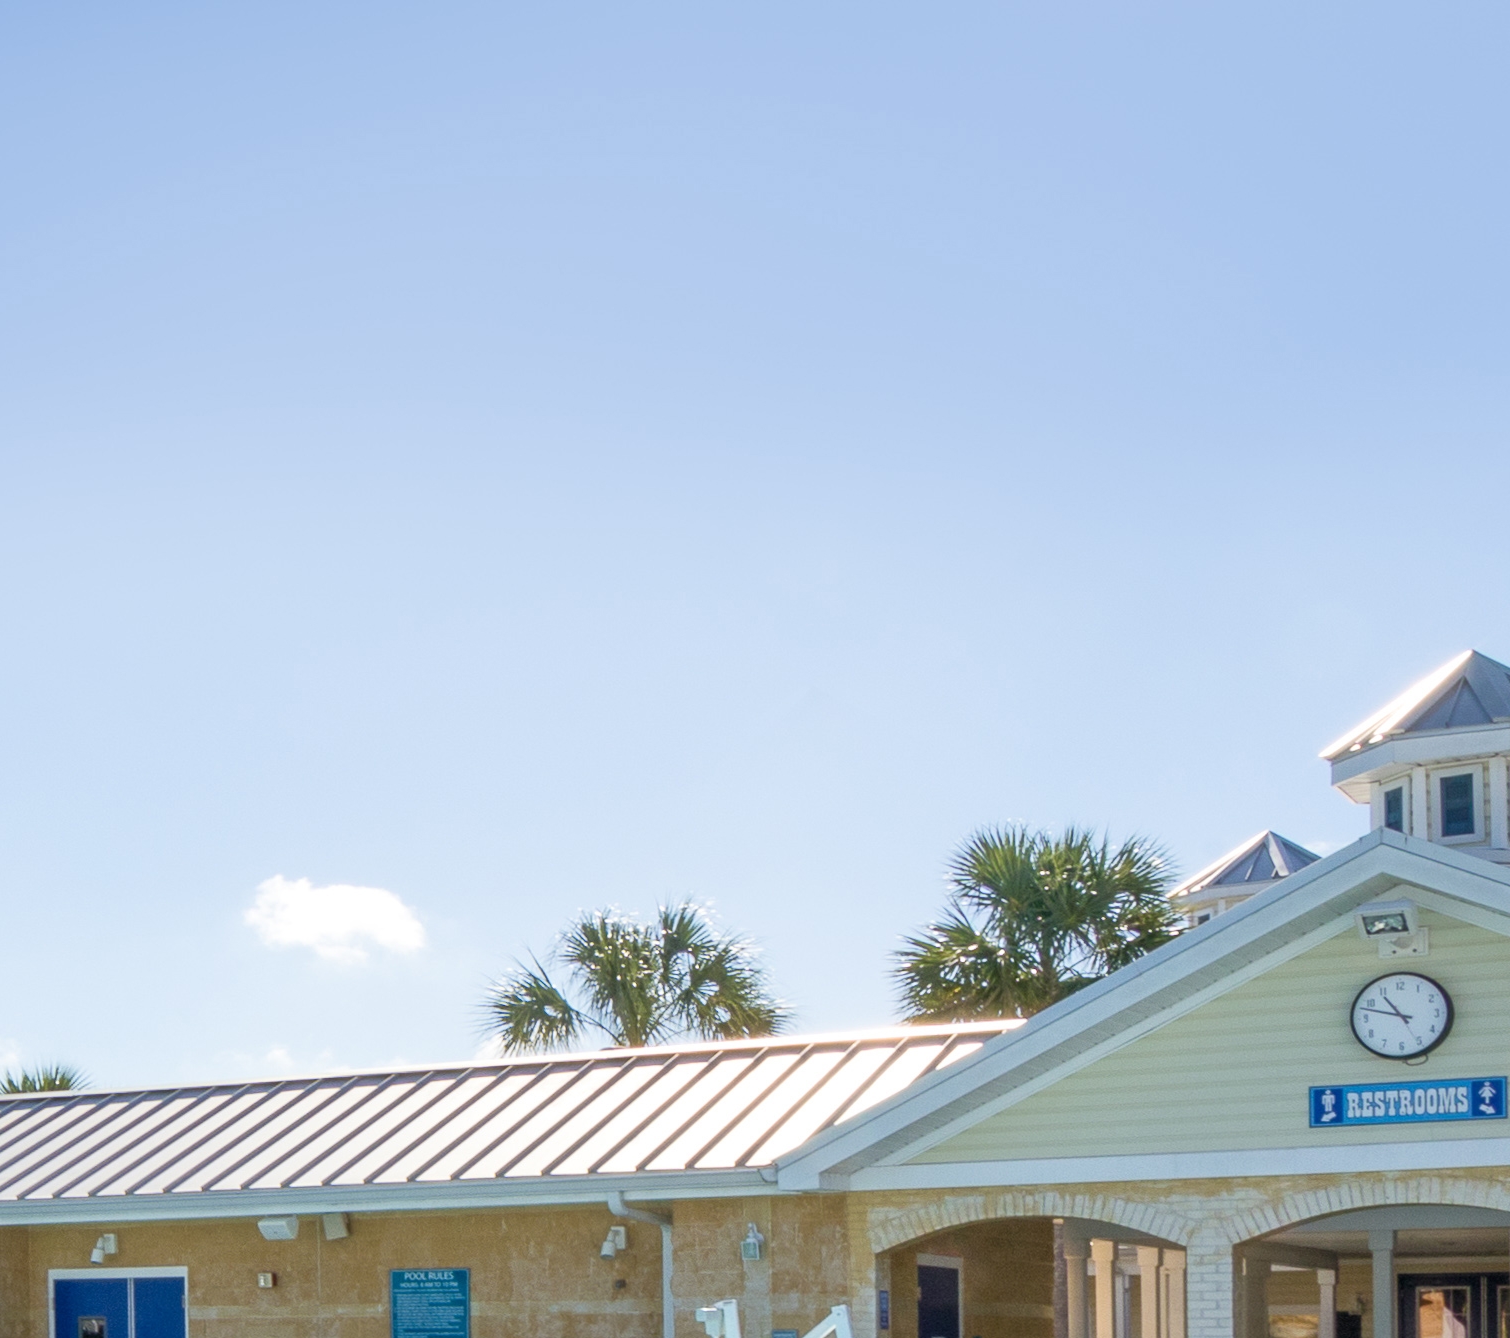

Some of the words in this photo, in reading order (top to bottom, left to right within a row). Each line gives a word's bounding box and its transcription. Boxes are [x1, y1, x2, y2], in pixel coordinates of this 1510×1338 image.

[1395, 981, 1405, 991] 12
[1379, 987, 1387, 996] 11
[1367, 998, 1376, 1007] 10
[1428, 994, 1435, 1003] 2
[1433, 1008, 1440, 1018] 3
[1363, 1014, 1369, 1023] 9
[1368, 1029, 1374, 1038] 8
[1429, 1024, 1435, 1034] 4
[1381, 1039, 1387, 1048] 7
[1416, 1036, 1422, 1046] 5
[1398, 1041, 1405, 1051] 6
[1346, 1085, 1469, 1118] RESTROOMS
[404, 1271, 427, 1280] POOL
[428, 1271, 454, 1280] RULES
